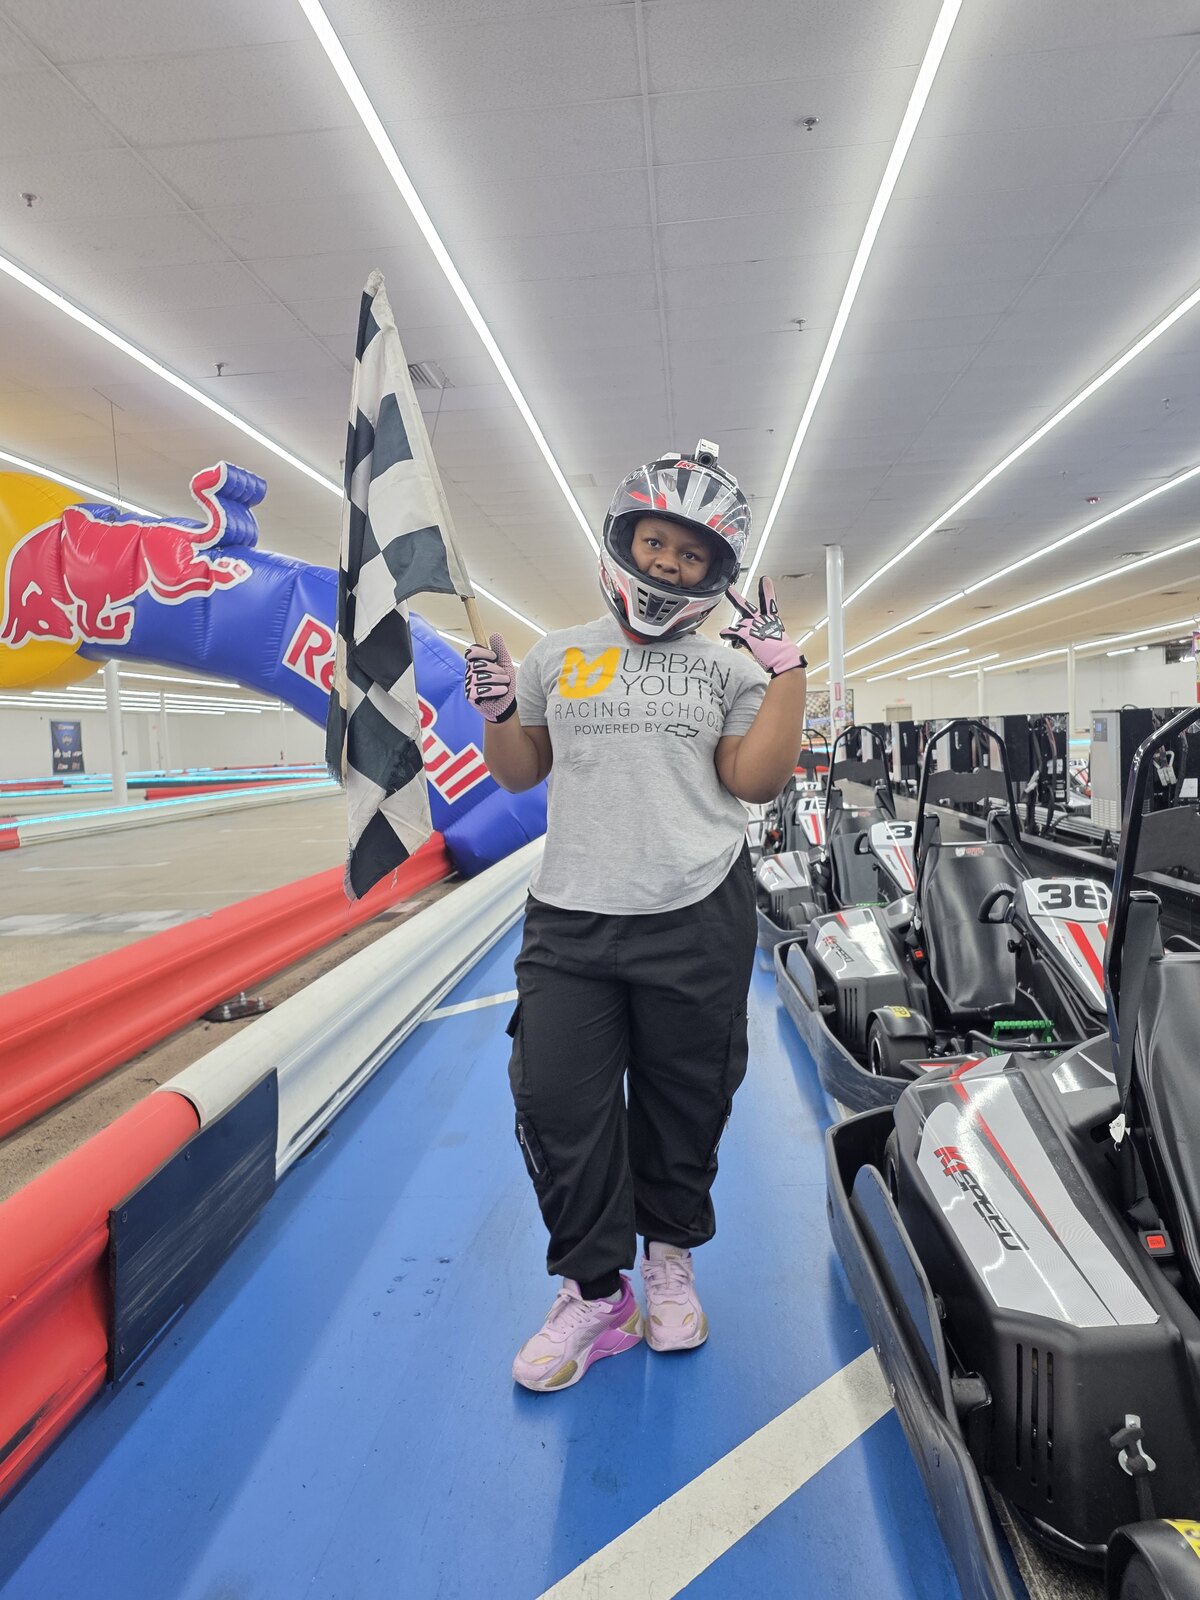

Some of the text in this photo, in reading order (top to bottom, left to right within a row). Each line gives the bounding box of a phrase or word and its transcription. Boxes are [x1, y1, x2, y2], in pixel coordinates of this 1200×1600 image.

[622, 648, 732, 691] URBAN
[554, 701, 721, 732] RACING SCHOOL
[574, 722, 663, 736] POWERED BY
[1037, 883, 1109, 911] 36
